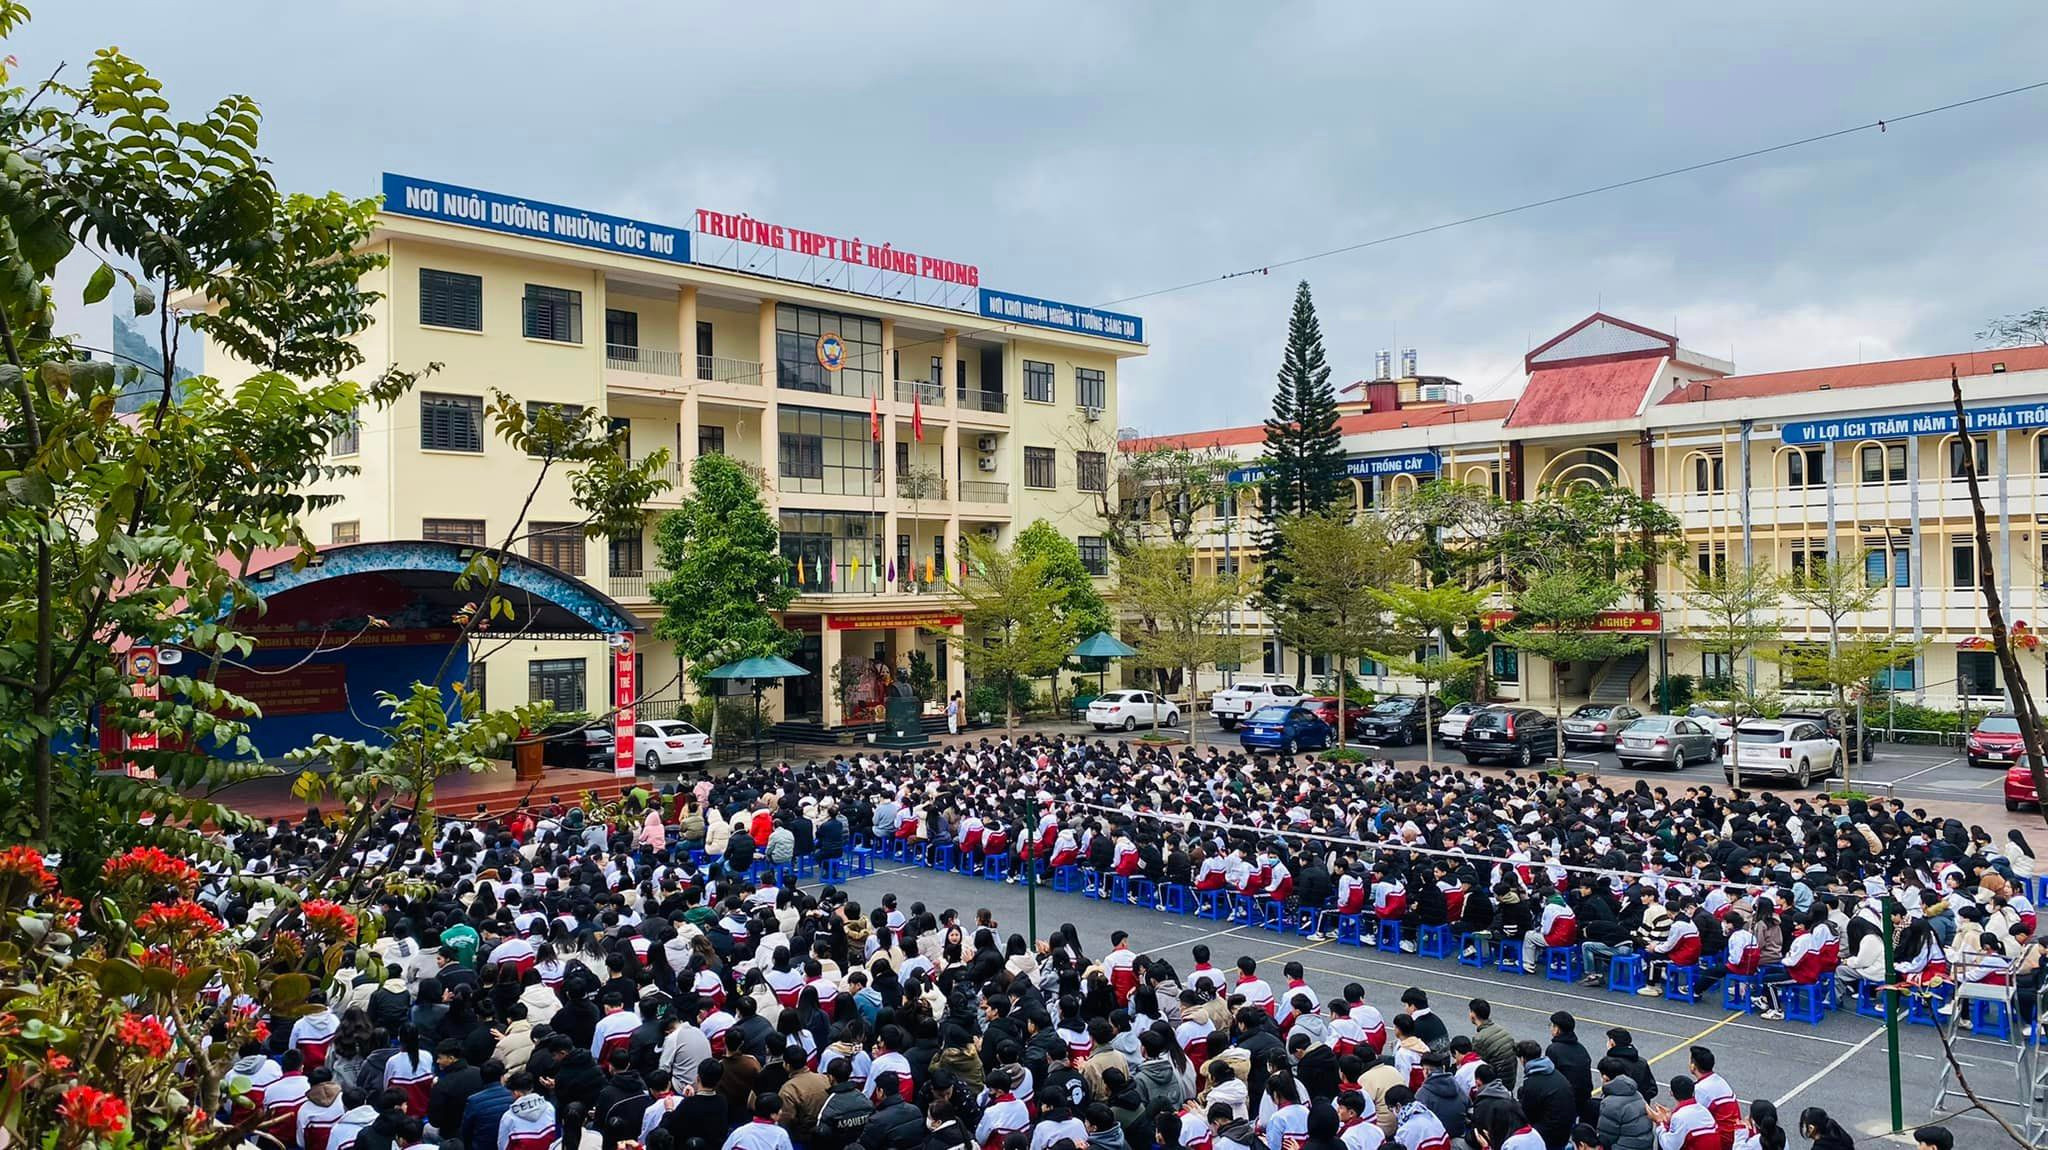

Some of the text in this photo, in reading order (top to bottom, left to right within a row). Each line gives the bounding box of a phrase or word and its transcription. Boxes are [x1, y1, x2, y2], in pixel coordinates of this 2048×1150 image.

[406, 185, 676, 254] NƠI NUÔI DƯỠNG NHỮNG ƯỚC MƠ
[696, 208, 979, 288] TRƯỜNG THPT LÊ HỒNG PHONG
[1802, 424, 1815, 440] VÌ
[1820, 424, 1839, 440] LỢI
[1843, 421, 1865, 437] ÍCH
[1870, 418, 1909, 435] TRĂM
[1913, 415, 1946, 432] NĂM
[1950, 412, 1973, 429] TÌ
[1977, 407, 2012, 427] PHẢI
[1347, 460, 1368, 474] PHẢI
[1404, 456, 1423, 470] CÂY
